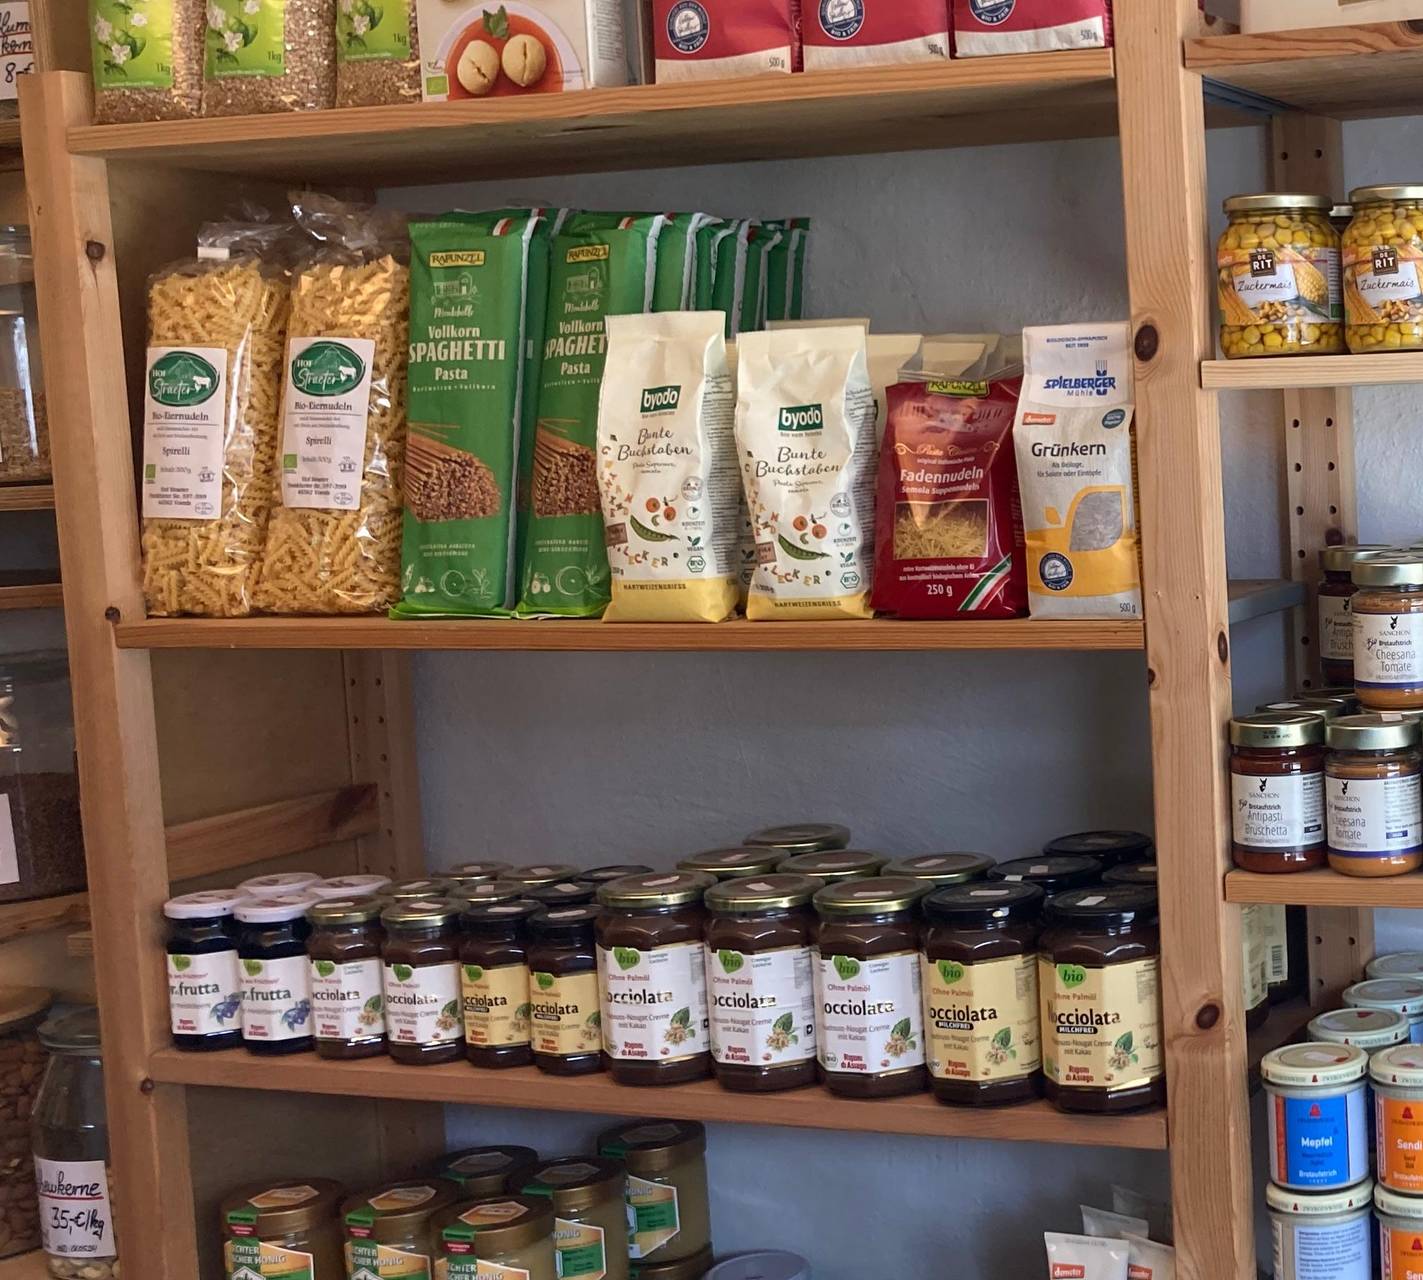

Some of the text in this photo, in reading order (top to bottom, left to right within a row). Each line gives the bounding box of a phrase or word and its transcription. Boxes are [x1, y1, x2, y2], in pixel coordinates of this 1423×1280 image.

[393, 33, 407, 46] 1kg
[568, 245, 609, 260] RAPUNZEL
[1380, 252, 1389, 260] DE
[431, 253, 483, 267] RAPUNZEL
[1252, 259, 1273, 271] RIT
[1374, 257, 1395, 269] RIT
[1237, 279, 1292, 292] Zuckermais
[1360, 278, 1415, 291] Zuckermais
[428, 325, 480, 339] Vollkorn
[559, 319, 603, 335] Vollkorn
[408, 340, 505, 363] SPAGHETTI
[435, 367, 468, 381] Pasta
[560, 362, 590, 375] Pasta
[642, 388, 679, 410] byodo
[1066, 389, 1093, 397] Mühle
[780, 406, 822, 430] byodo
[637, 425, 674, 445] Bunte
[777, 446, 827, 463] Bunte
[1031, 441, 1107, 458] Grünkern
[755, 460, 843, 478] Buchstaben
[899, 465, 984, 483] Fadennudeln
[926, 584, 953, 597] 250 g
[1119, 601, 1130, 612] 500
[1375, 649, 1416, 660] Cheesana
[1380, 661, 1413, 672] Tomate
[1247, 811, 1283, 825] Antipasti
[1244, 823, 1288, 836] Bruschetta
[1335, 827, 1362, 840] Tomate
[937, 1021, 971, 1030] MILCHFREI
[1058, 1026, 1095, 1034] MILCHFREI
[1301, 1136, 1334, 1150] Mepfel
[51, 1207, 105, 1240] 35,-€/kg
[1054, 1266, 1082, 1278] demeter
